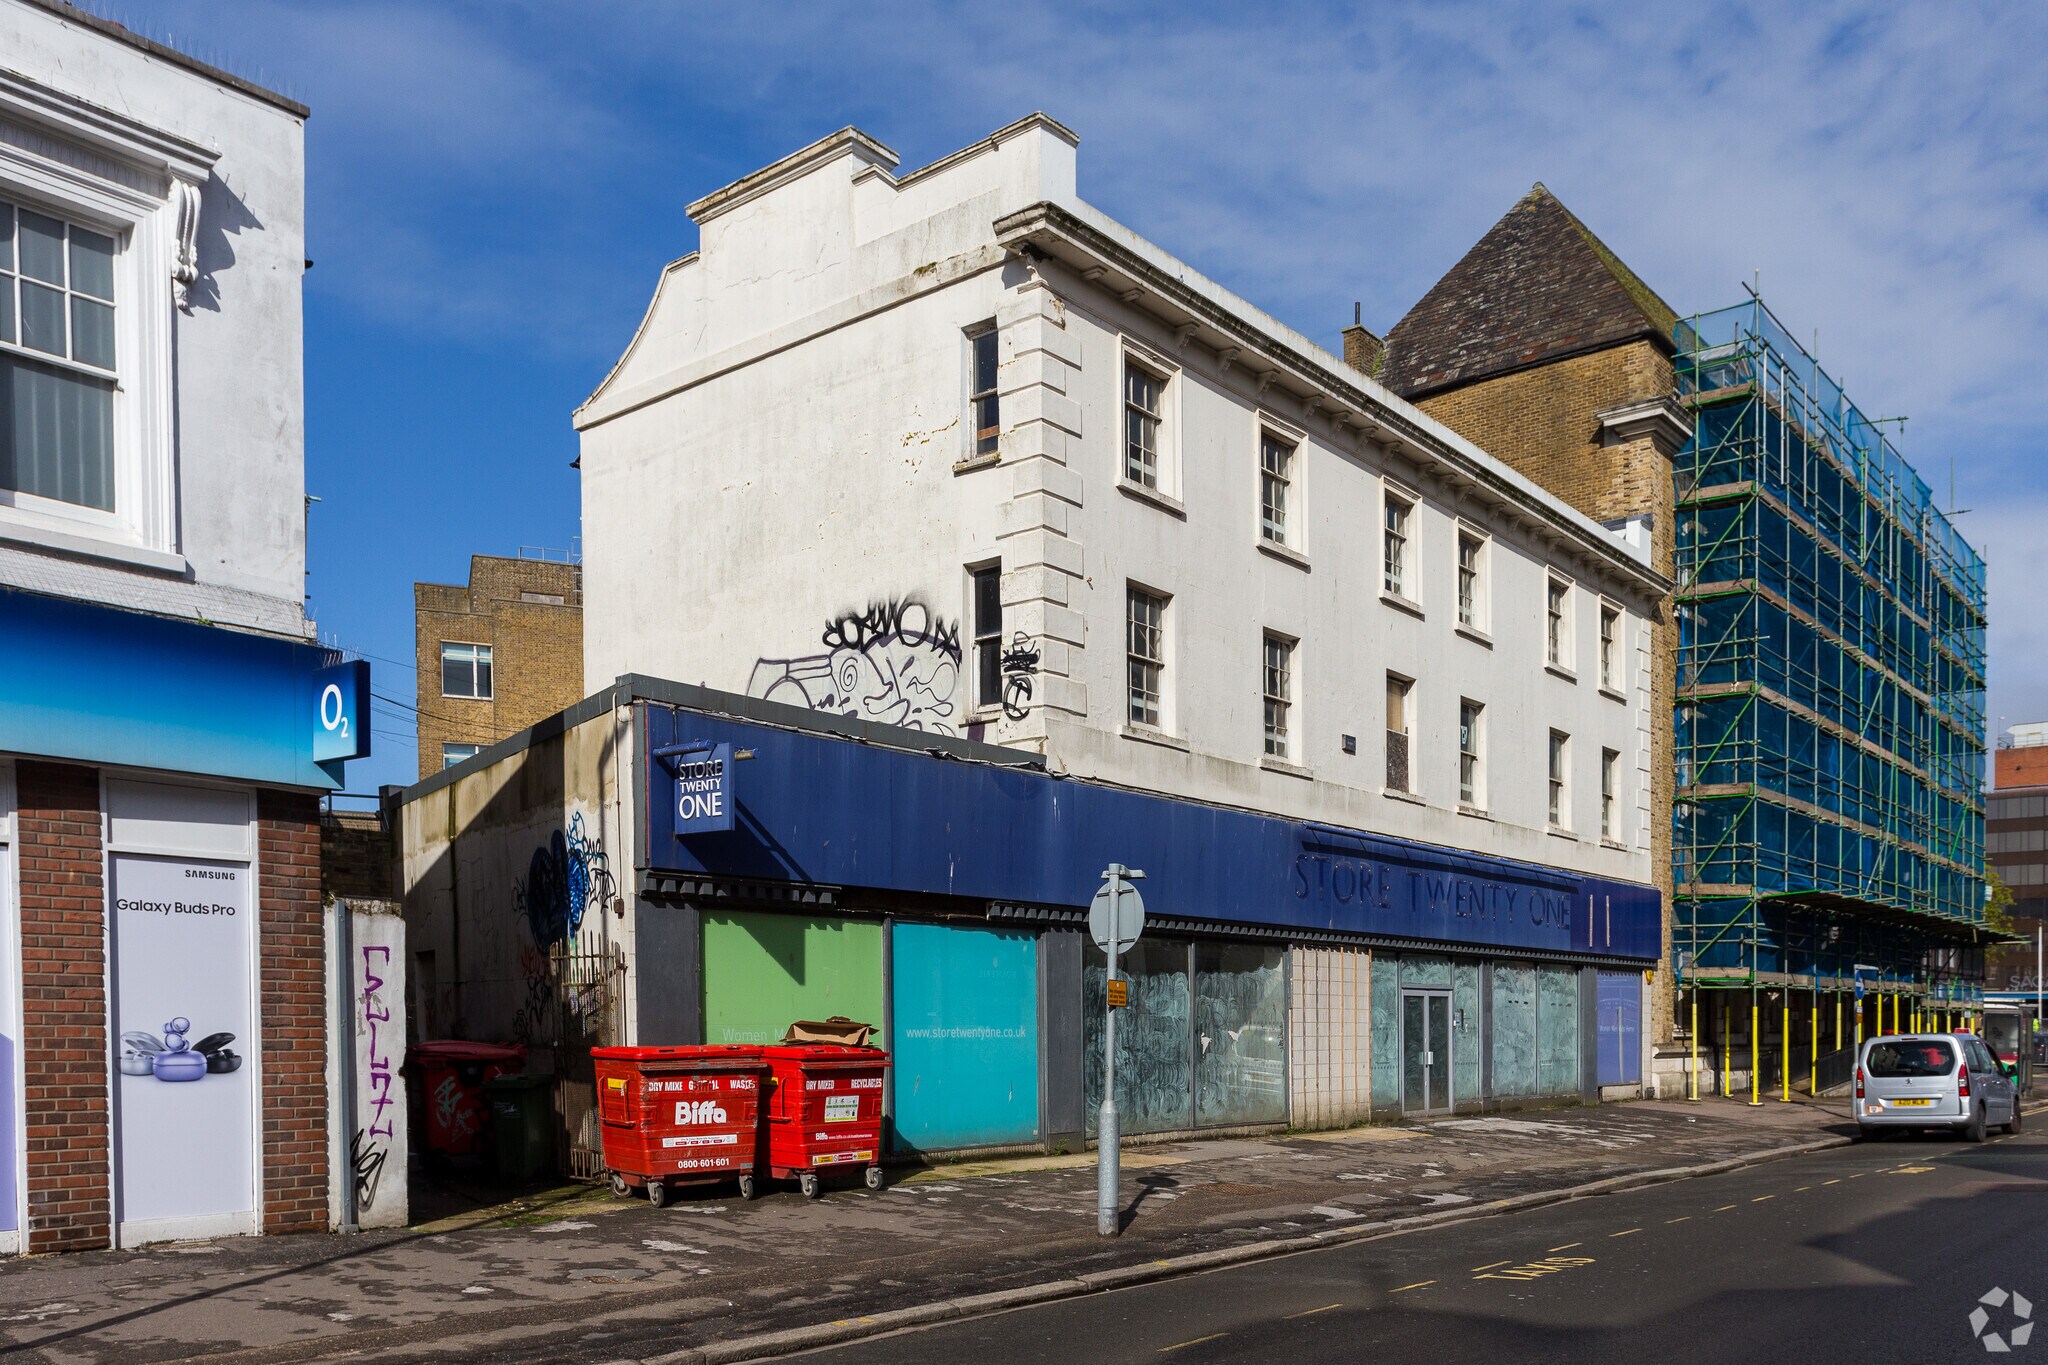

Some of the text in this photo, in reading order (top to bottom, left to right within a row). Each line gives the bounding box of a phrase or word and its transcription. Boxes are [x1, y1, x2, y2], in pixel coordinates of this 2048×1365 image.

[679, 759, 722, 780] STORE
[679, 778, 722, 793] TWENTY
[679, 792, 722, 819] ONE
[185, 869, 235, 880] SAMSUNG
[1296, 853, 1570, 930] STORE TWENTY ONE
[116, 898, 235, 916] Galaxy Buds Pro
[722, 1028, 767, 1042] Women
[906, 1026, 1026, 1040] www.storetwentyone.co.uk
[648, 1082, 662, 1092] DRY
[805, 1081, 816, 1090] DRY
[817, 1080, 835, 1090] MIXED
[675, 1101, 727, 1126] Biffa
